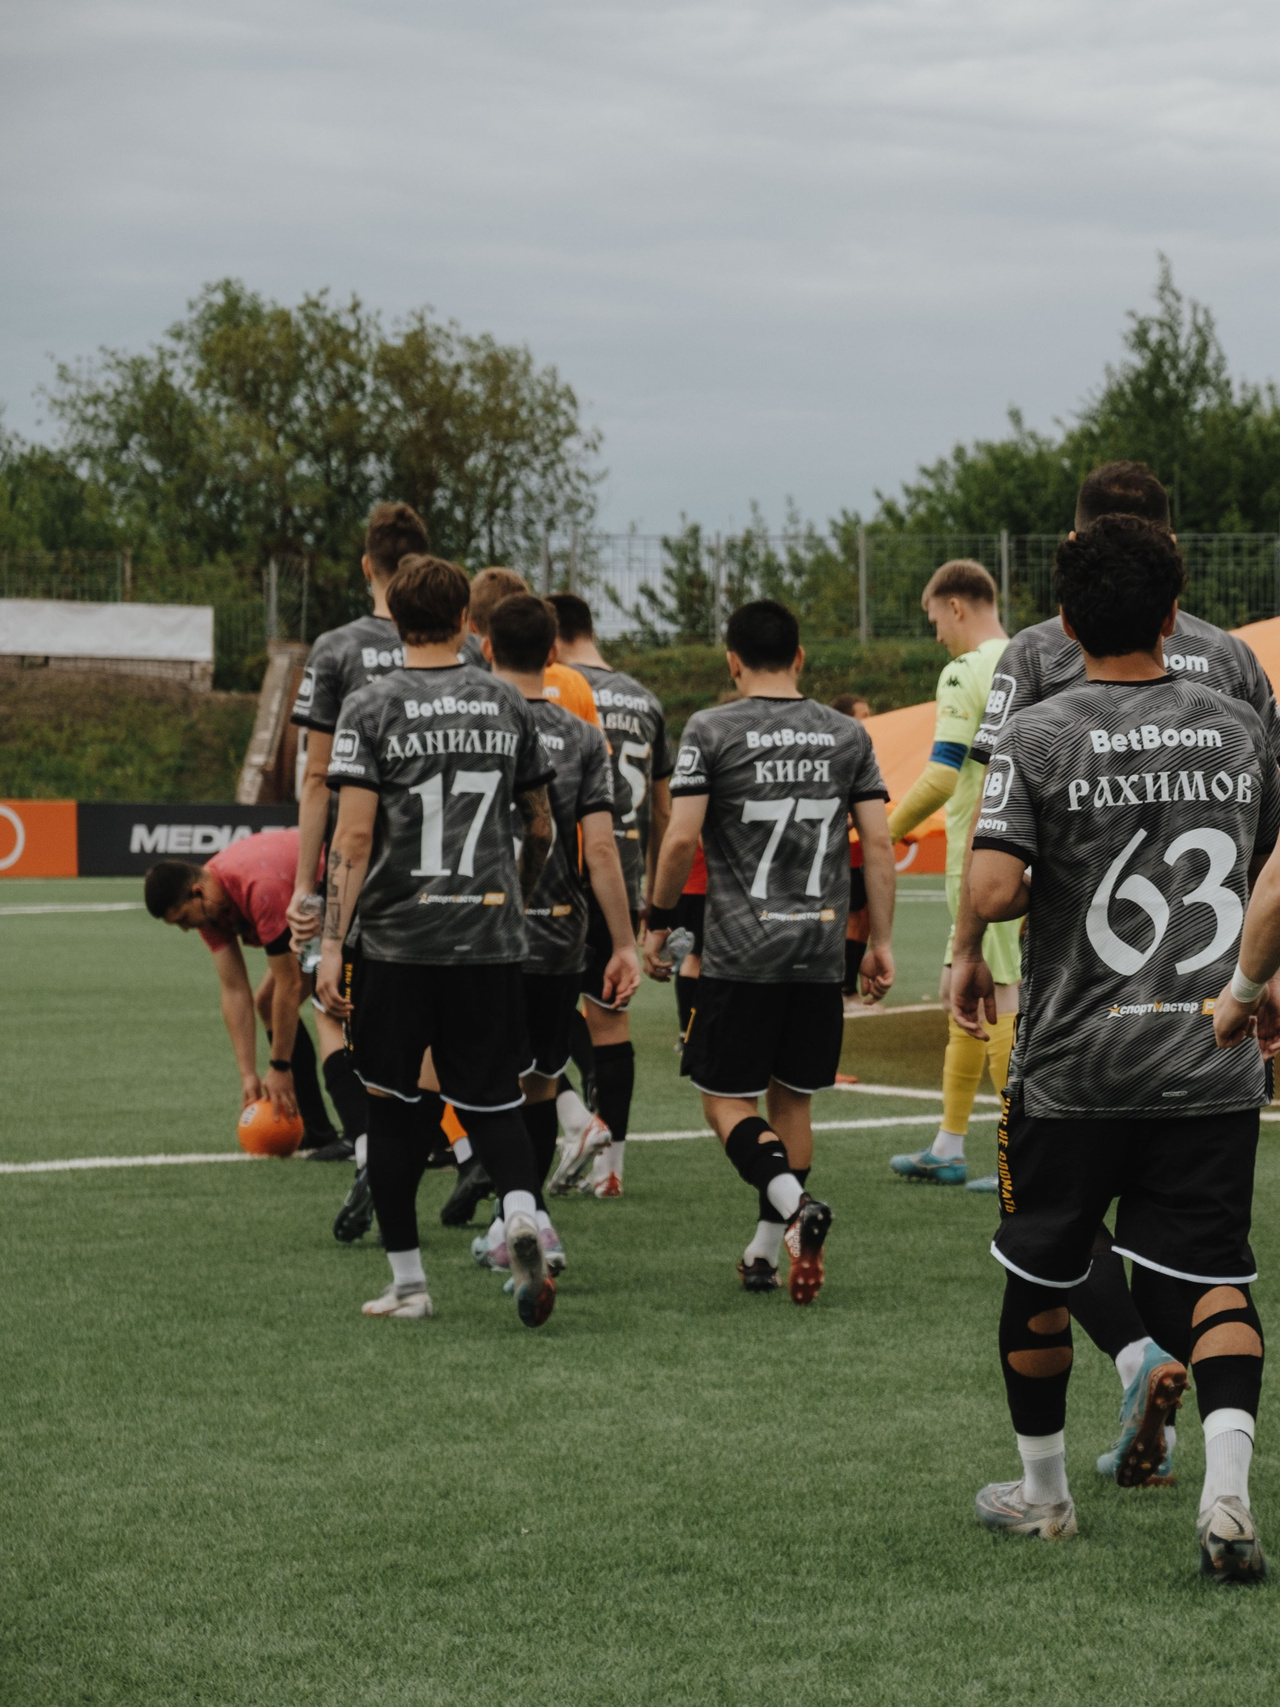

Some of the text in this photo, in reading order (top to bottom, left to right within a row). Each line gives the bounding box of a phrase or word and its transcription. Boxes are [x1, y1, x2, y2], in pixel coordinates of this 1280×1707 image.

[405, 696, 499, 719] BetBoom
[386, 729, 519, 761] ДАНИЛИН
[746, 728, 836, 749] BetBoom
[1090, 725, 1222, 753] BetBoom
[754, 759, 830, 784] КИРЯ
[1067, 770, 1252, 811] РАХИМОВ
[409, 770, 503, 878] 17
[741, 796, 841, 900] 77
[1085, 827, 1244, 976] 63
